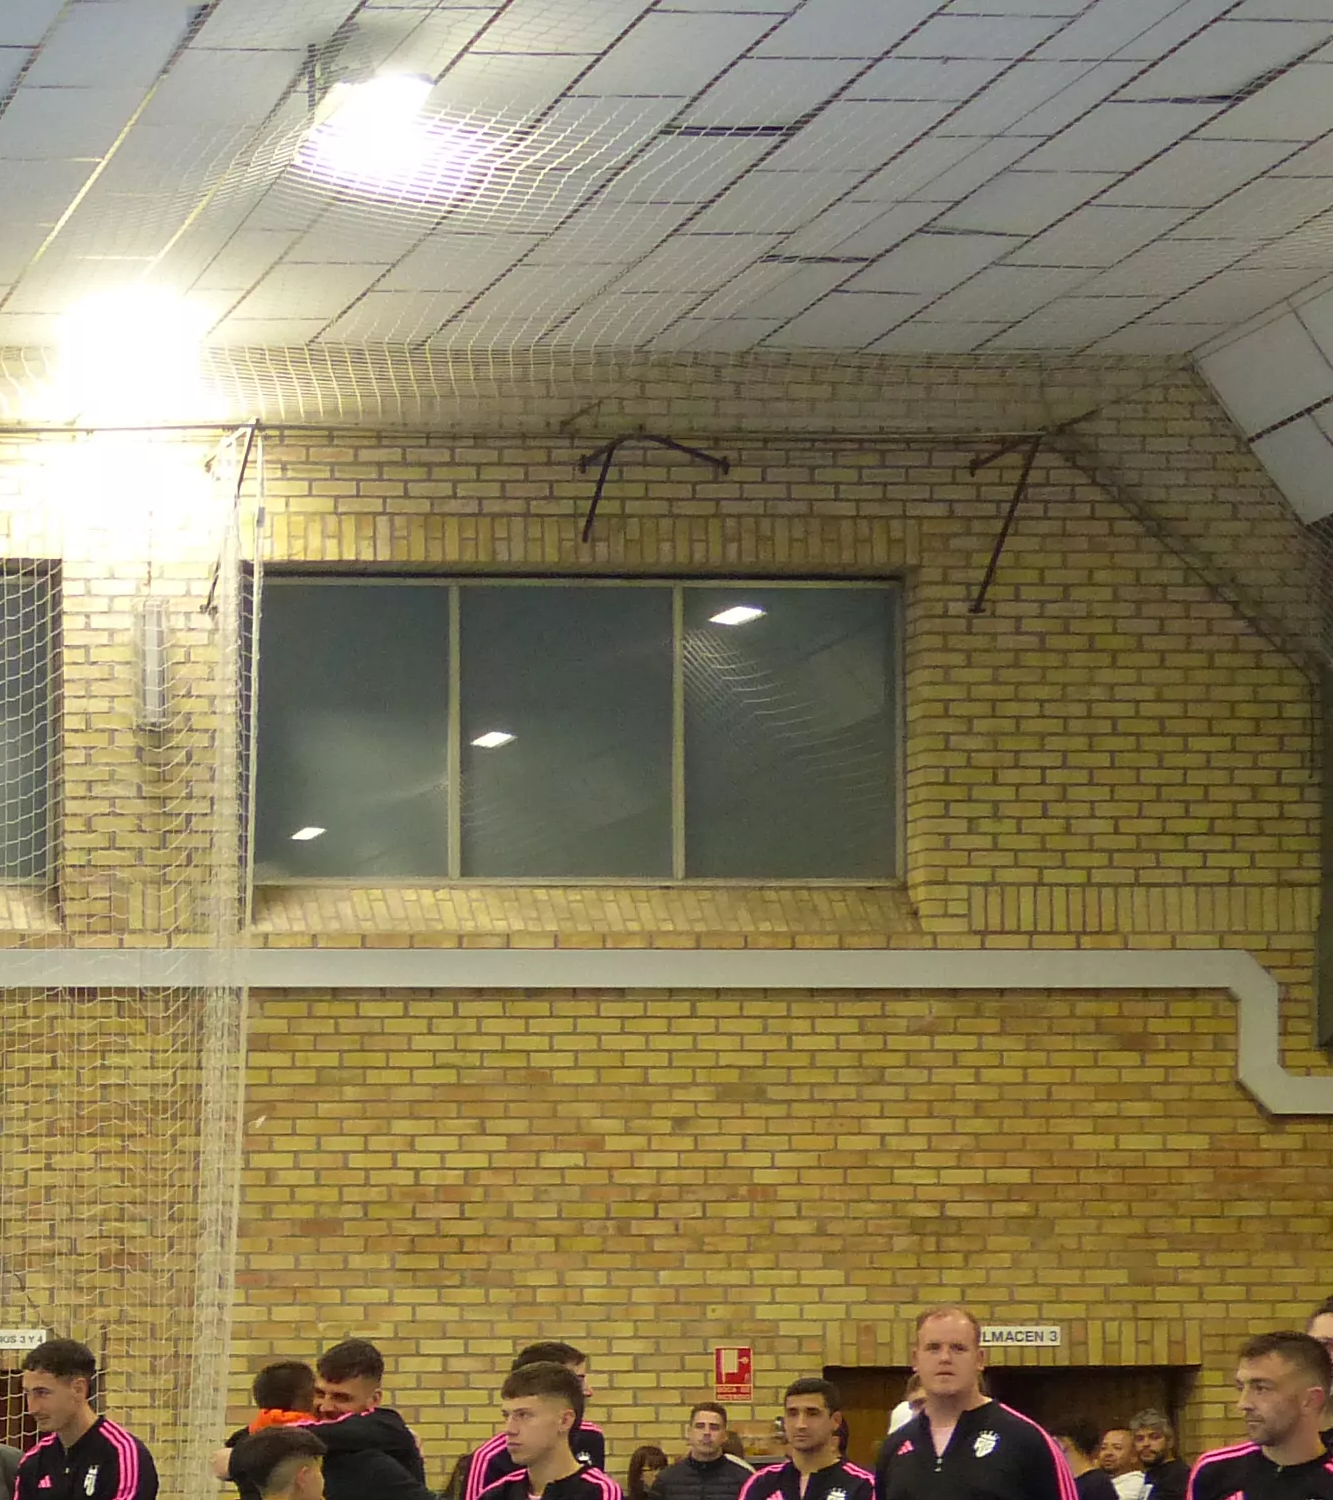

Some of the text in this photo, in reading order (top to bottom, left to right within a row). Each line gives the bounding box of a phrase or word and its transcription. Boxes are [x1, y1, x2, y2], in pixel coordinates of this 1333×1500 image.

[20, 1335, 26, 1344] 3
[28, 1335, 34, 1344] Y
[37, 1335, 43, 1344] 4
[981, 1331, 1058, 1342] LMACEN 3
